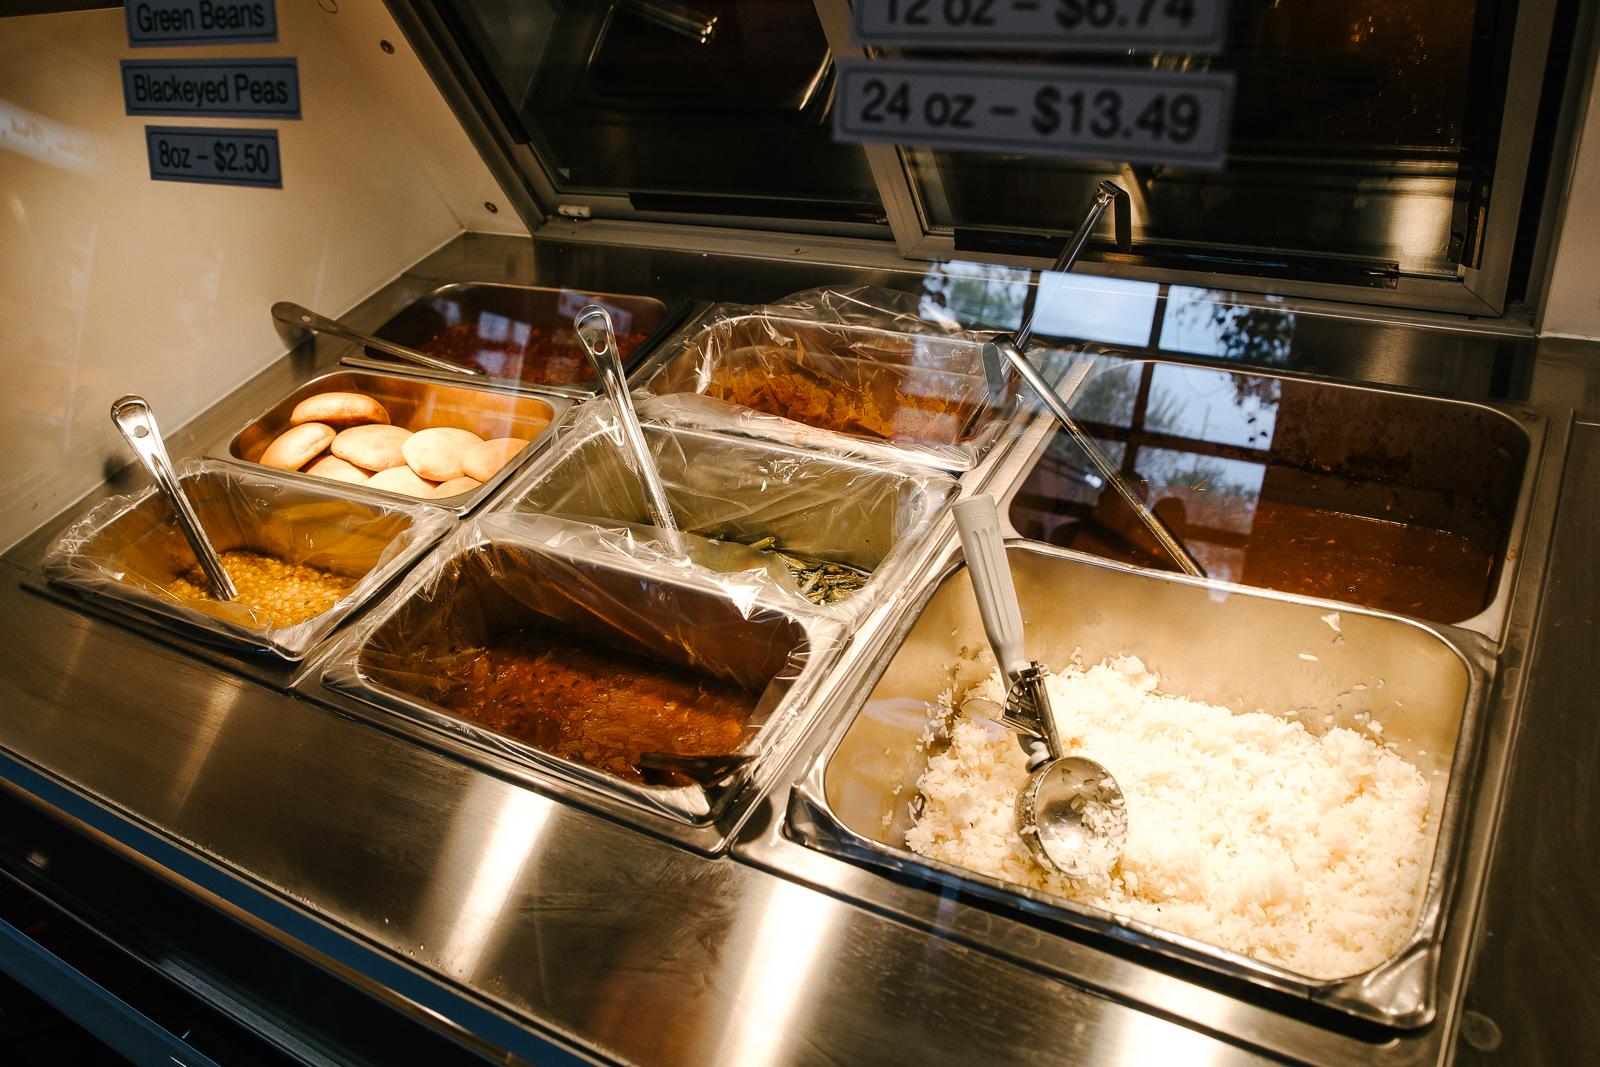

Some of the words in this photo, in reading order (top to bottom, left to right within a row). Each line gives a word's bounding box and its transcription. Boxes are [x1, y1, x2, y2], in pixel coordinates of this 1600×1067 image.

[137, 4, 195, 32] Green
[200, 0, 265, 29] Beans
[885, 0, 929, 25] 12
[942, 0, 995, 26] oz
[134, 73, 229, 107] Blackeyed
[234, 73, 288, 104] Peas
[860, 79, 912, 123] 24
[923, 92, 974, 128] oz
[1031, 86, 1200, 144] $13.49
[158, 140, 192, 169] 8oz
[213, 140, 270, 173] $2.50
